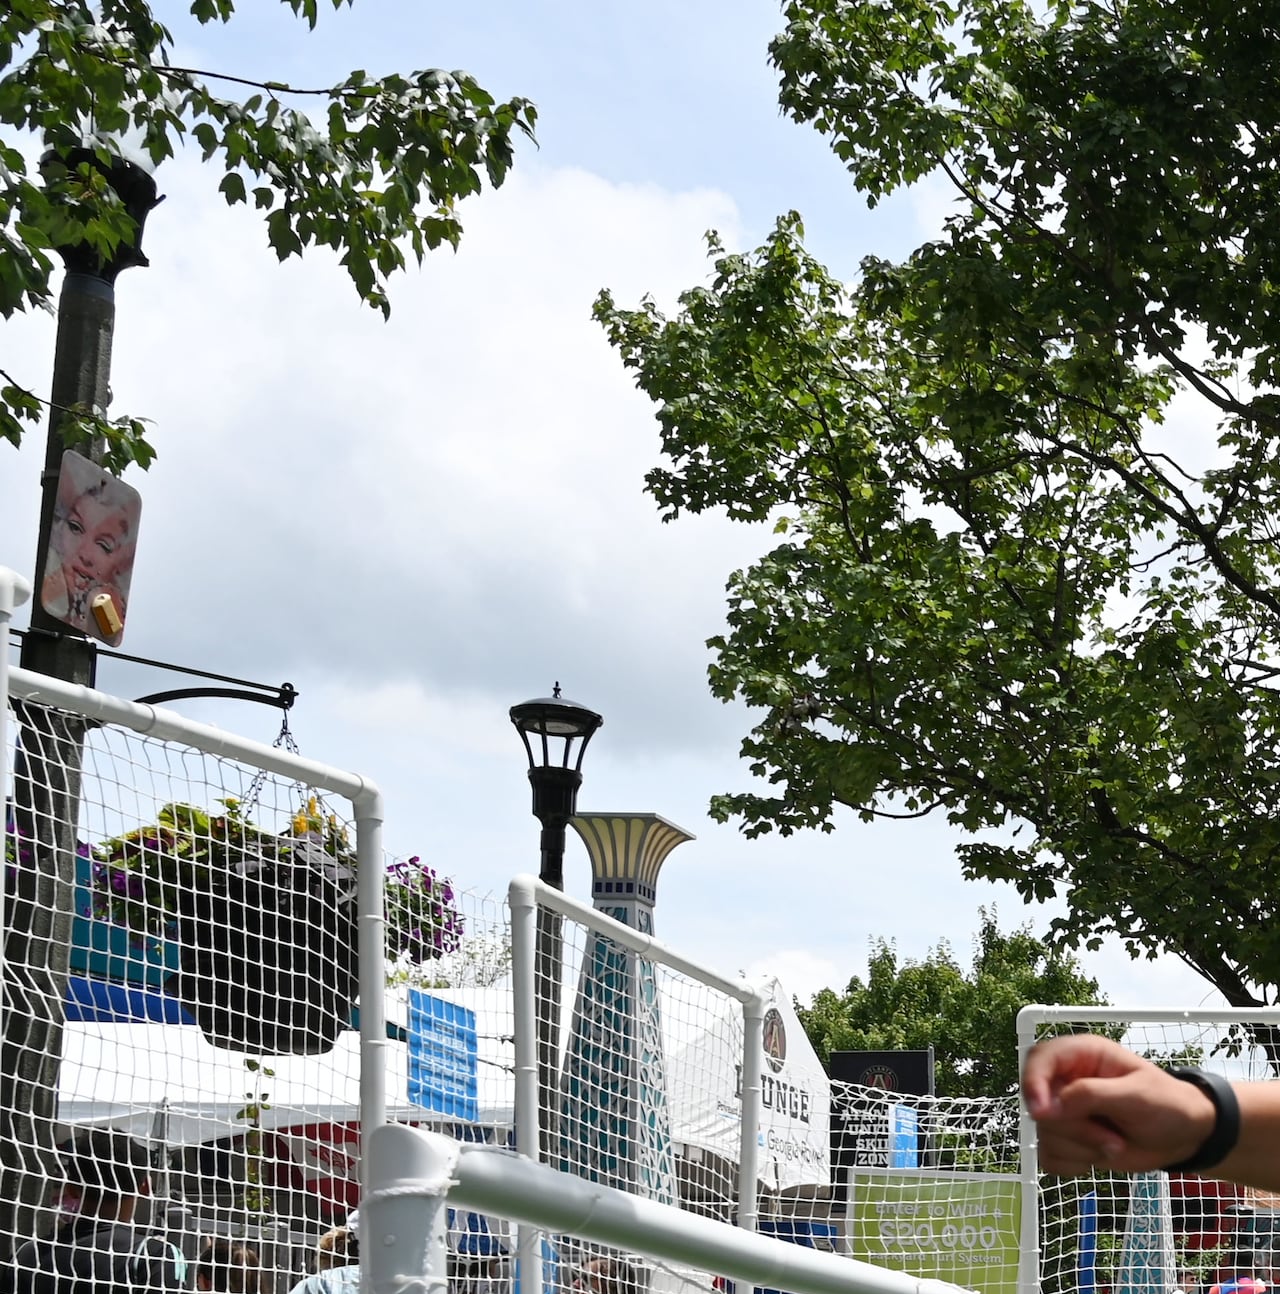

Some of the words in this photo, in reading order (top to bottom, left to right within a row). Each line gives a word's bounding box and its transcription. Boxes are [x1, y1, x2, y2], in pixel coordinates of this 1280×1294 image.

[858, 1153, 889, 1165] ZON
[875, 1202, 922, 1215] Enter
[927, 1203, 945, 1216] to
[951, 1203, 987, 1217] WIN
[880, 1221, 997, 1249] $20,000
[959, 1253, 1001, 1264] System
